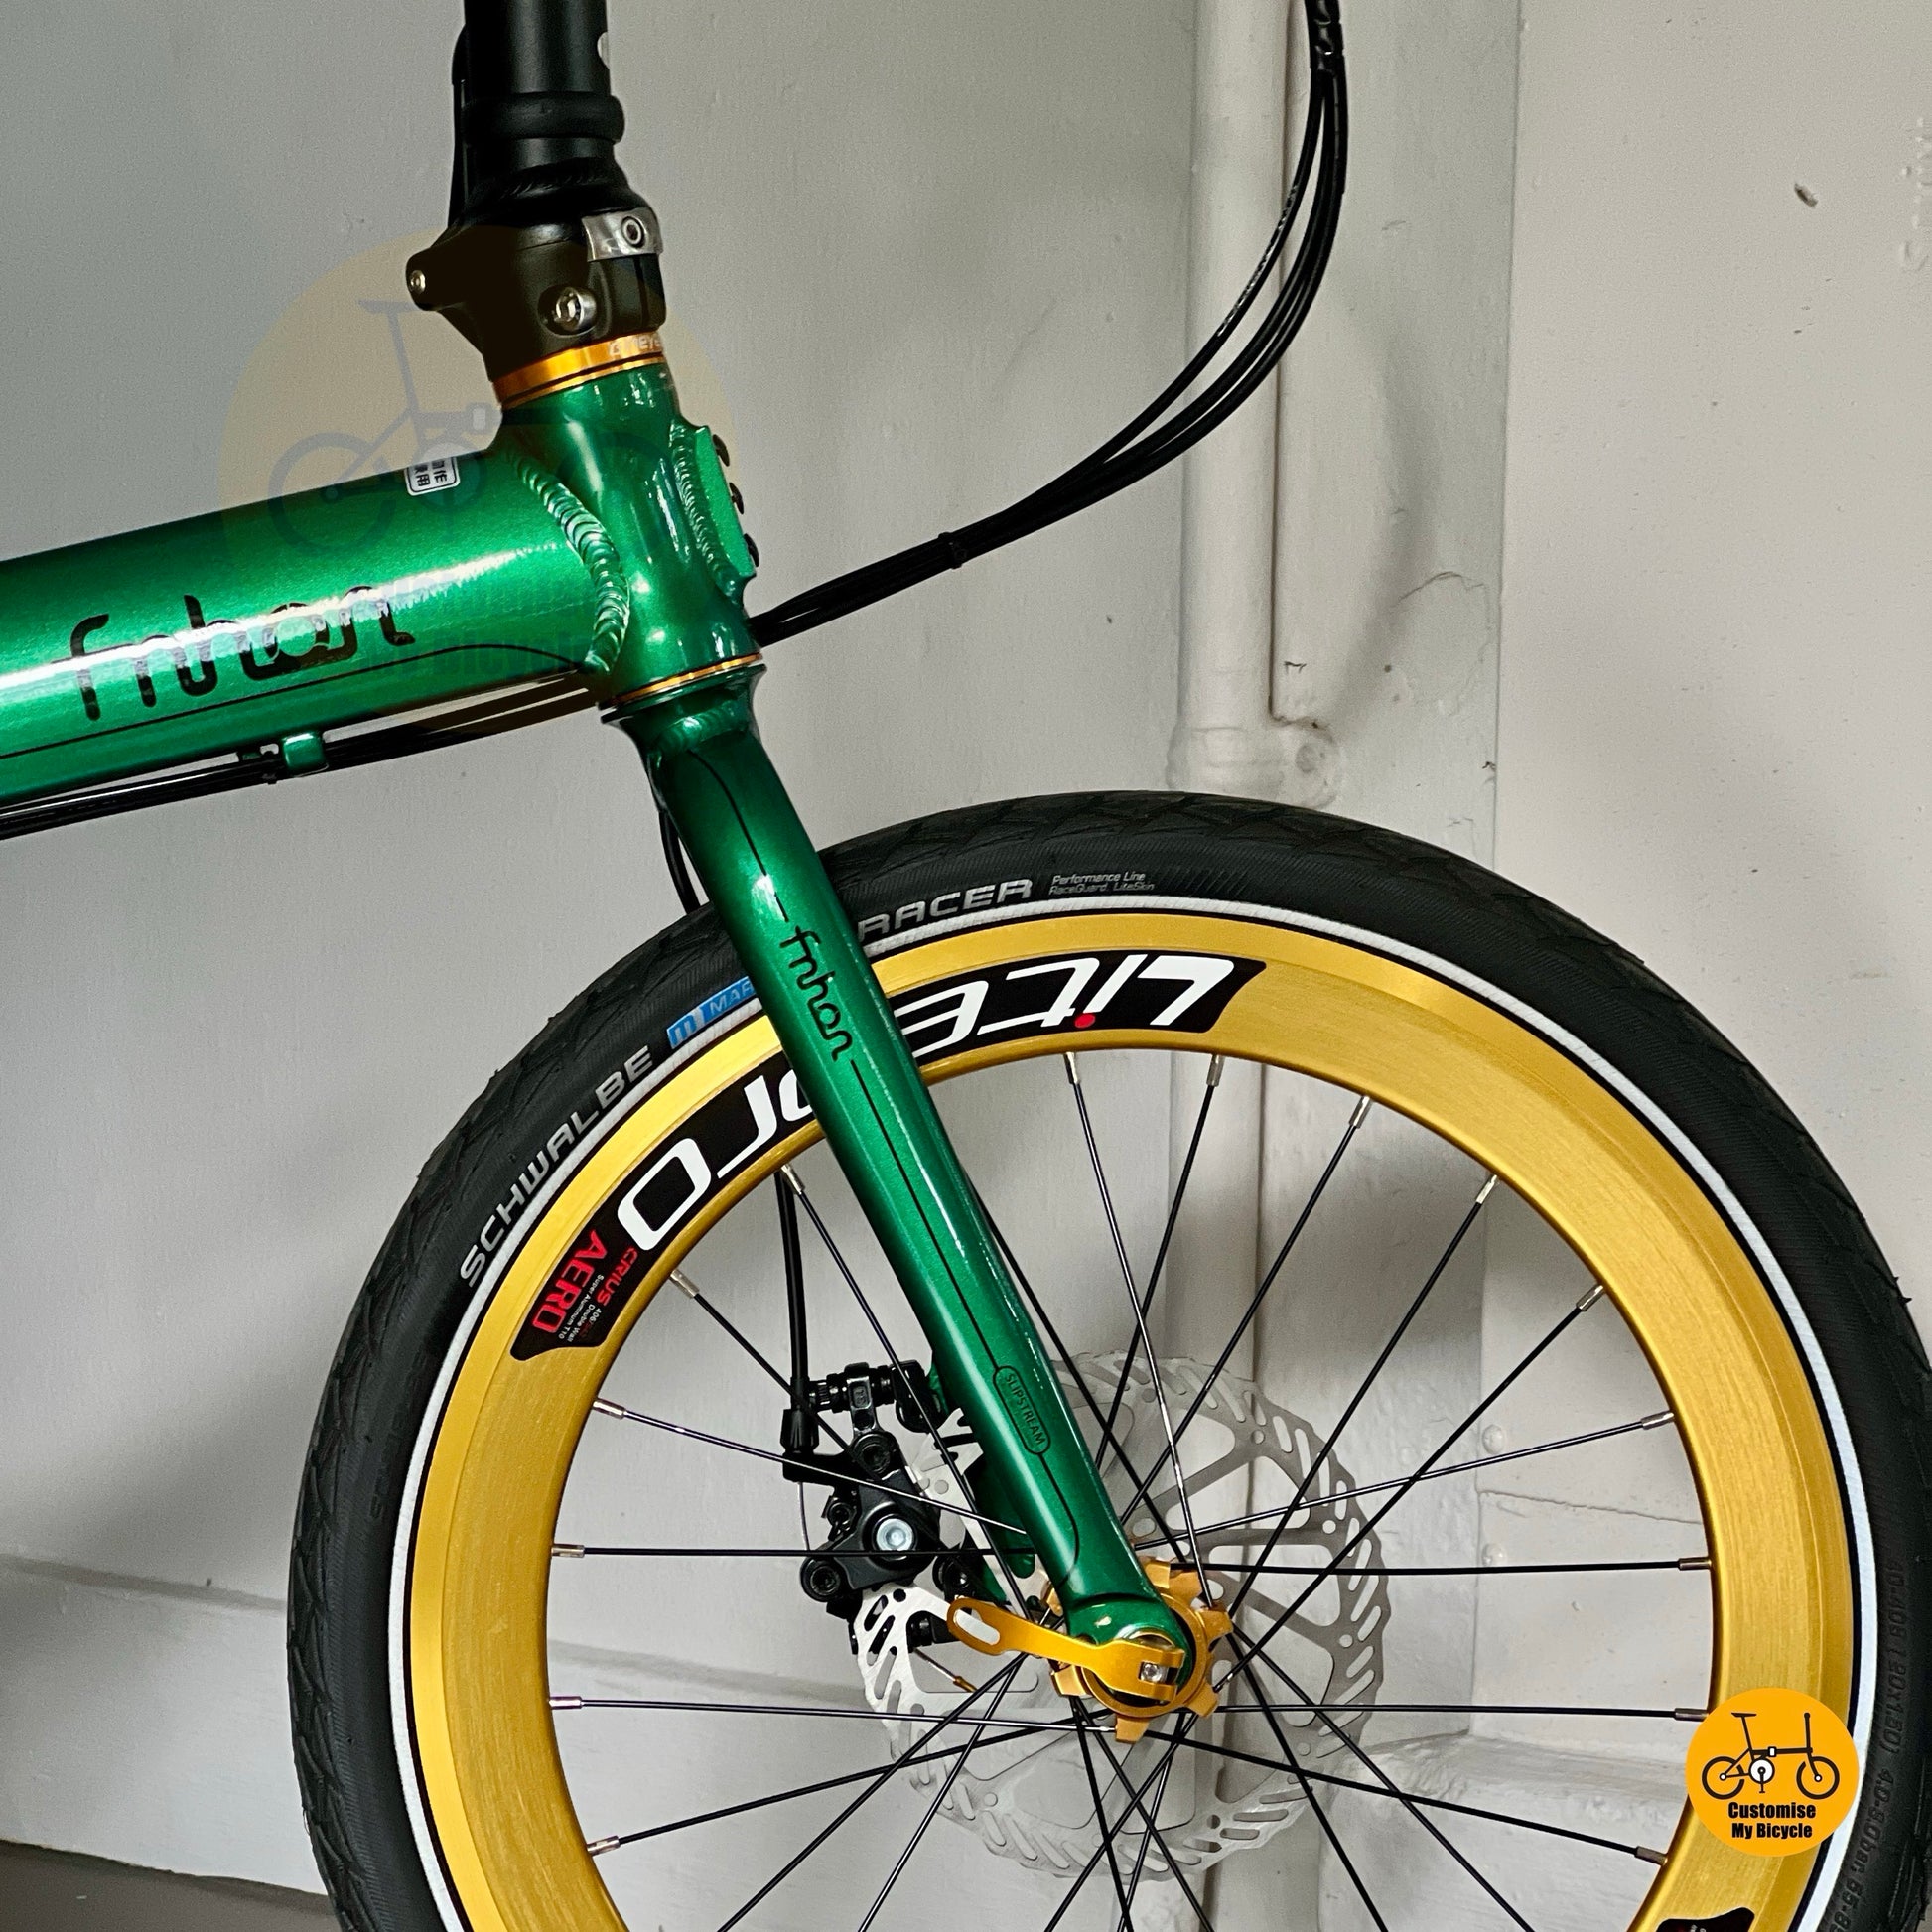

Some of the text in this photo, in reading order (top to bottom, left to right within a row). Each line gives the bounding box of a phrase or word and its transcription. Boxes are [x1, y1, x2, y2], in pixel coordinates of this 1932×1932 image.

[1052, 871, 1146, 885] Performance Line
[460, 1044, 654, 1287] SCHWALBE
[857, 877, 1034, 943] RACER
[531, 1229, 608, 1334] AERO
[588, 1273, 605, 1295] Super
[596, 1246, 638, 1307] CRIUS
[576, 1303, 596, 1327] Double
[1004, 1371, 1046, 1446] SLIPSTREAM
